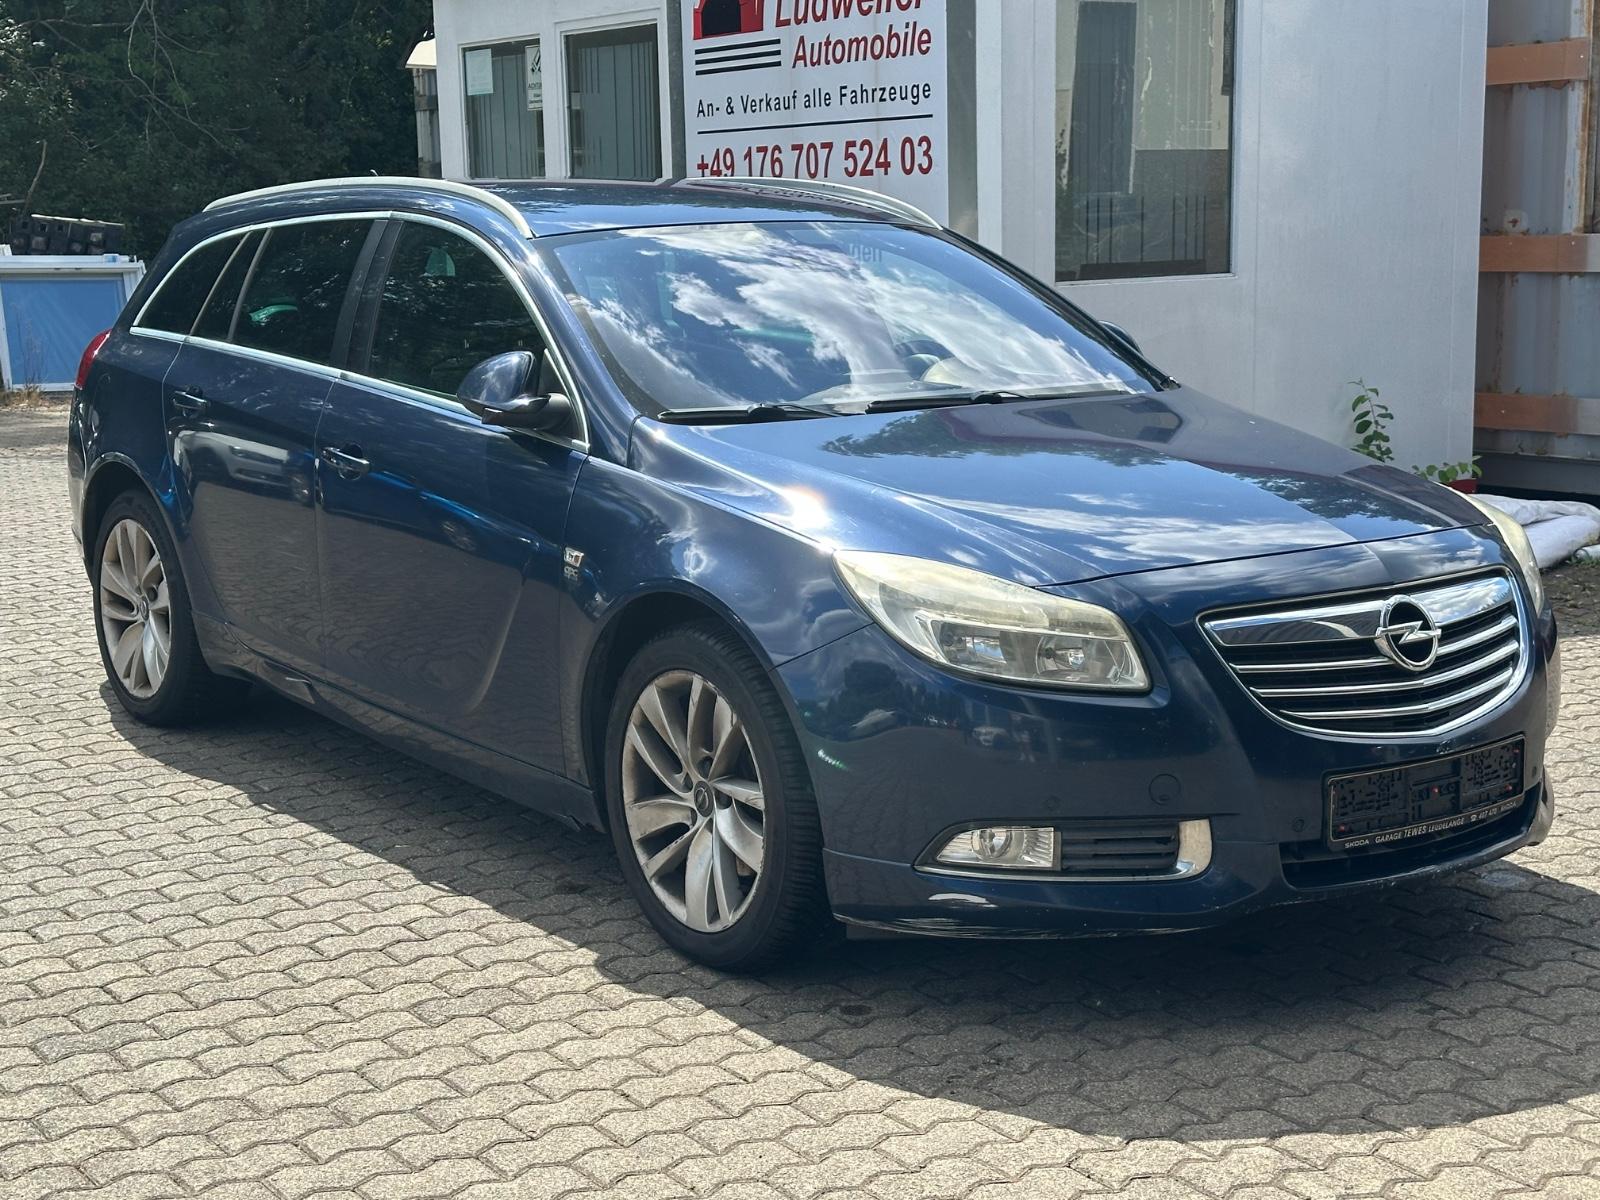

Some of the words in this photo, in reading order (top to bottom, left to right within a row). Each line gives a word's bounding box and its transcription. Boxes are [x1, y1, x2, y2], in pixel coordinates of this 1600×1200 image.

[792, 21, 932, 69] Automobile
[696, 98, 720, 118] An-
[725, 97, 735, 115] &
[740, 90, 797, 113] Verkauf
[803, 88, 832, 108] alle
[839, 82, 931, 106] Fahrzeuge
[697, 147, 735, 177] +49
[744, 145, 783, 178] 176
[791, 141, 834, 179] 707
[843, 137, 891, 178] 524
[901, 135, 933, 176] 03
[1344, 838, 1370, 849] SKODA
[1375, 832, 1402, 844] GARAGE
[1403, 825, 1427, 839] TEWES
